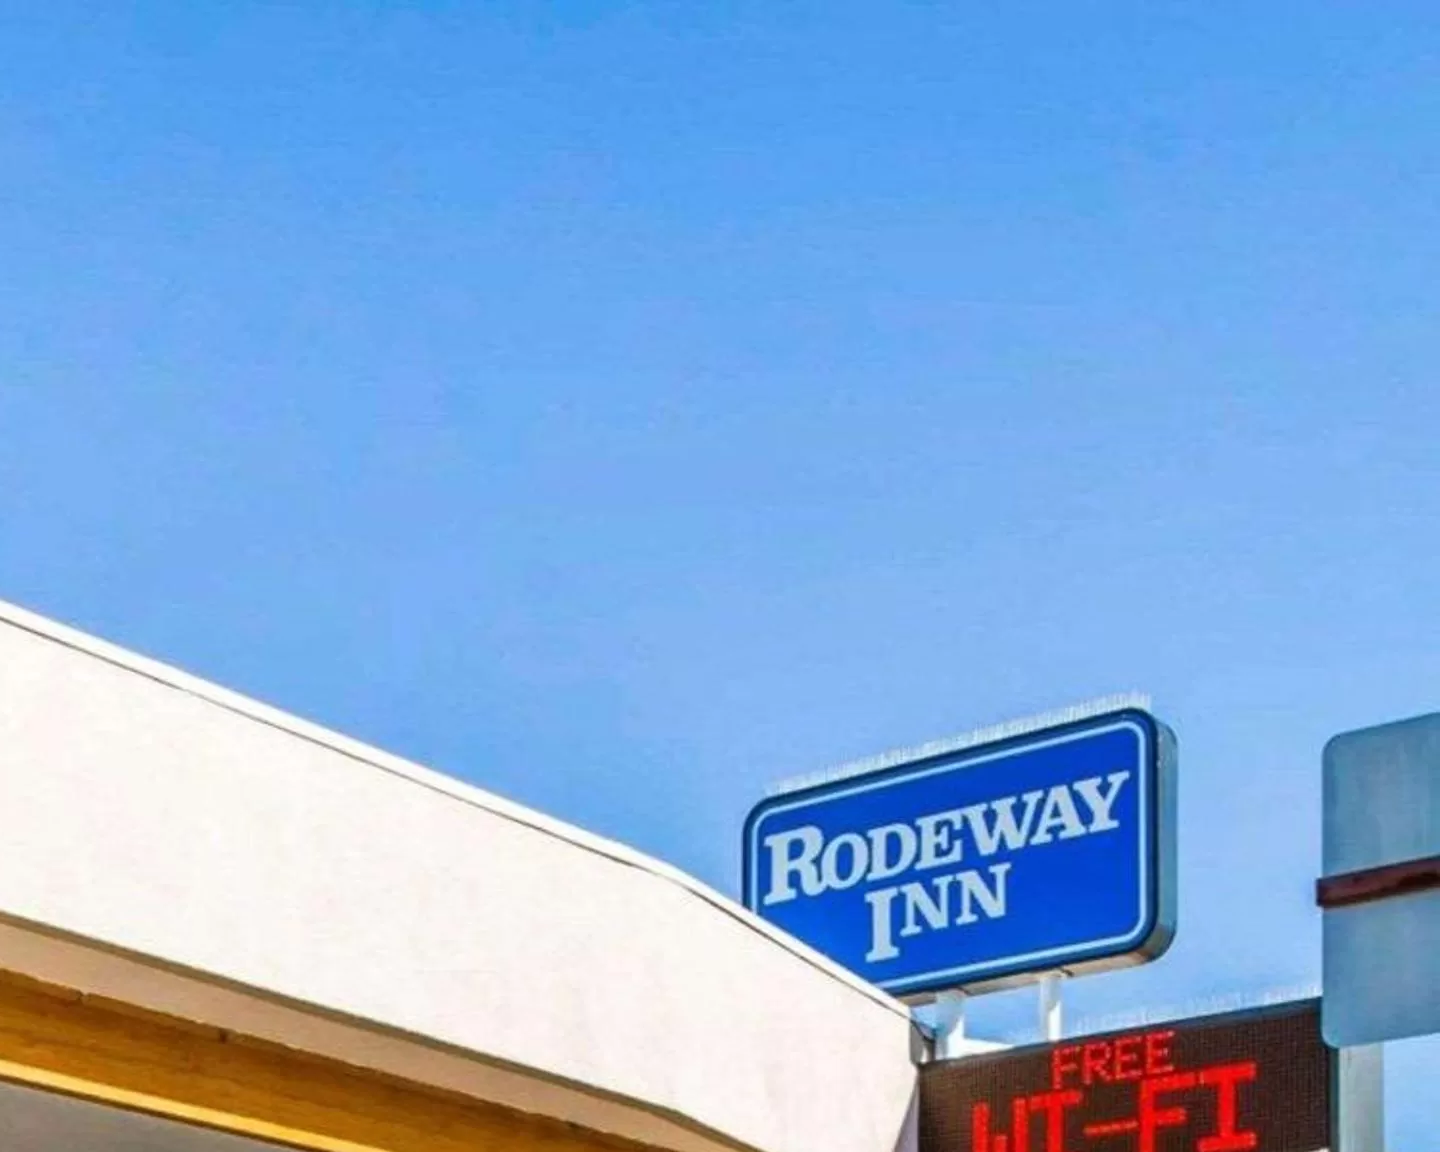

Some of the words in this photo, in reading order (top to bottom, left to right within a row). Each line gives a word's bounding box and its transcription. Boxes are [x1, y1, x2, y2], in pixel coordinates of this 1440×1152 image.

[764, 771, 1130, 905] RODEWAY
[865, 864, 1010, 962] INN
[1053, 1031, 1176, 1089] FREE
